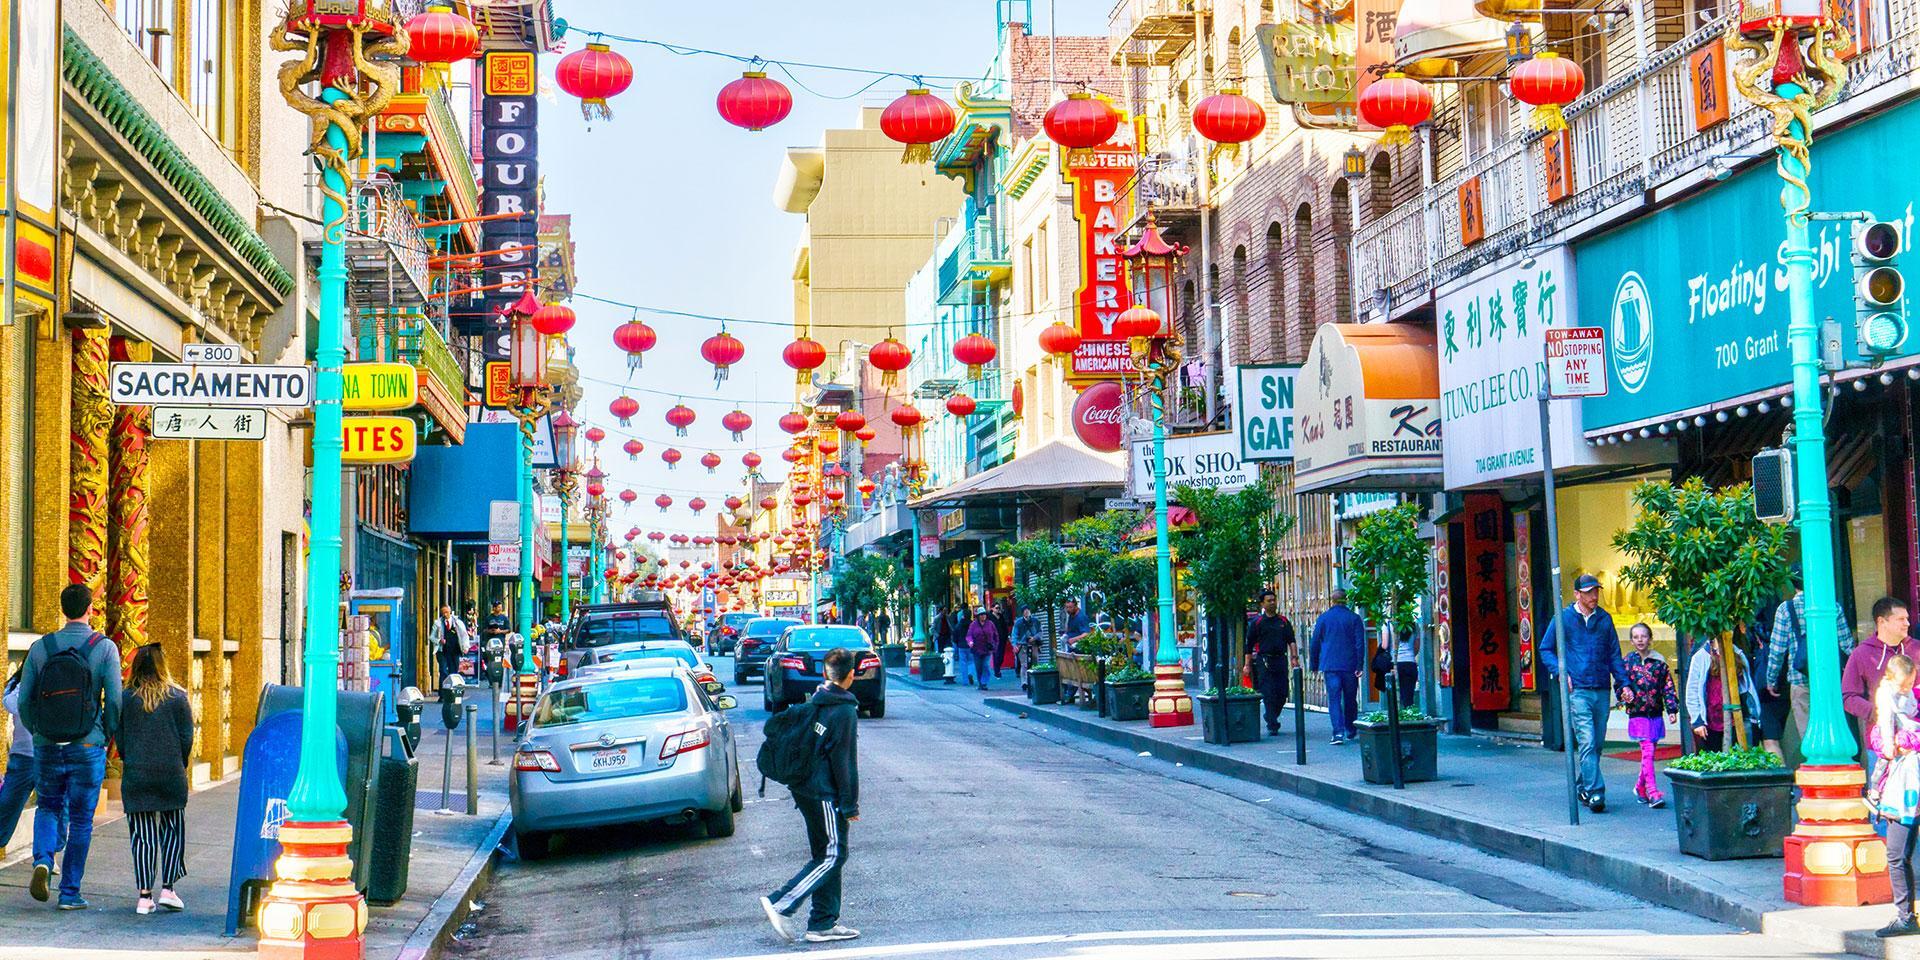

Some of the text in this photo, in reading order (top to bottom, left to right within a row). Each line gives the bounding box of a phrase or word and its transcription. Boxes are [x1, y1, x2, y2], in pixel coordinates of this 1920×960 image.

[496, 101, 526, 216] FOUR
[1093, 179, 1119, 335] BAKERY
[1688, 259, 1768, 325] Floating
[1443, 270, 1557, 364] 東利珠寶行
[1548, 329, 1600, 339] TOW-AWAY
[204, 347, 233, 361] 800
[1074, 343, 1130, 357] CHINESE
[1547, 341, 1602, 357] NO STOPPING
[1715, 340, 1739, 369] 700
[1744, 330, 1779, 361] Grant
[1075, 358, 1119, 371] AMERICAN
[1566, 359, 1587, 371] ANY
[117, 371, 304, 399] SACRAMENTO
[371, 373, 408, 398] TOWN
[1565, 373, 1590, 385] TIME
[1444, 382, 1479, 422] TUNG
[1481, 373, 1507, 411] LEE
[1509, 366, 1533, 402] CO.
[165, 413, 253, 433] 唐人街
[1475, 447, 1535, 474] 704 GRANT AVENUE
